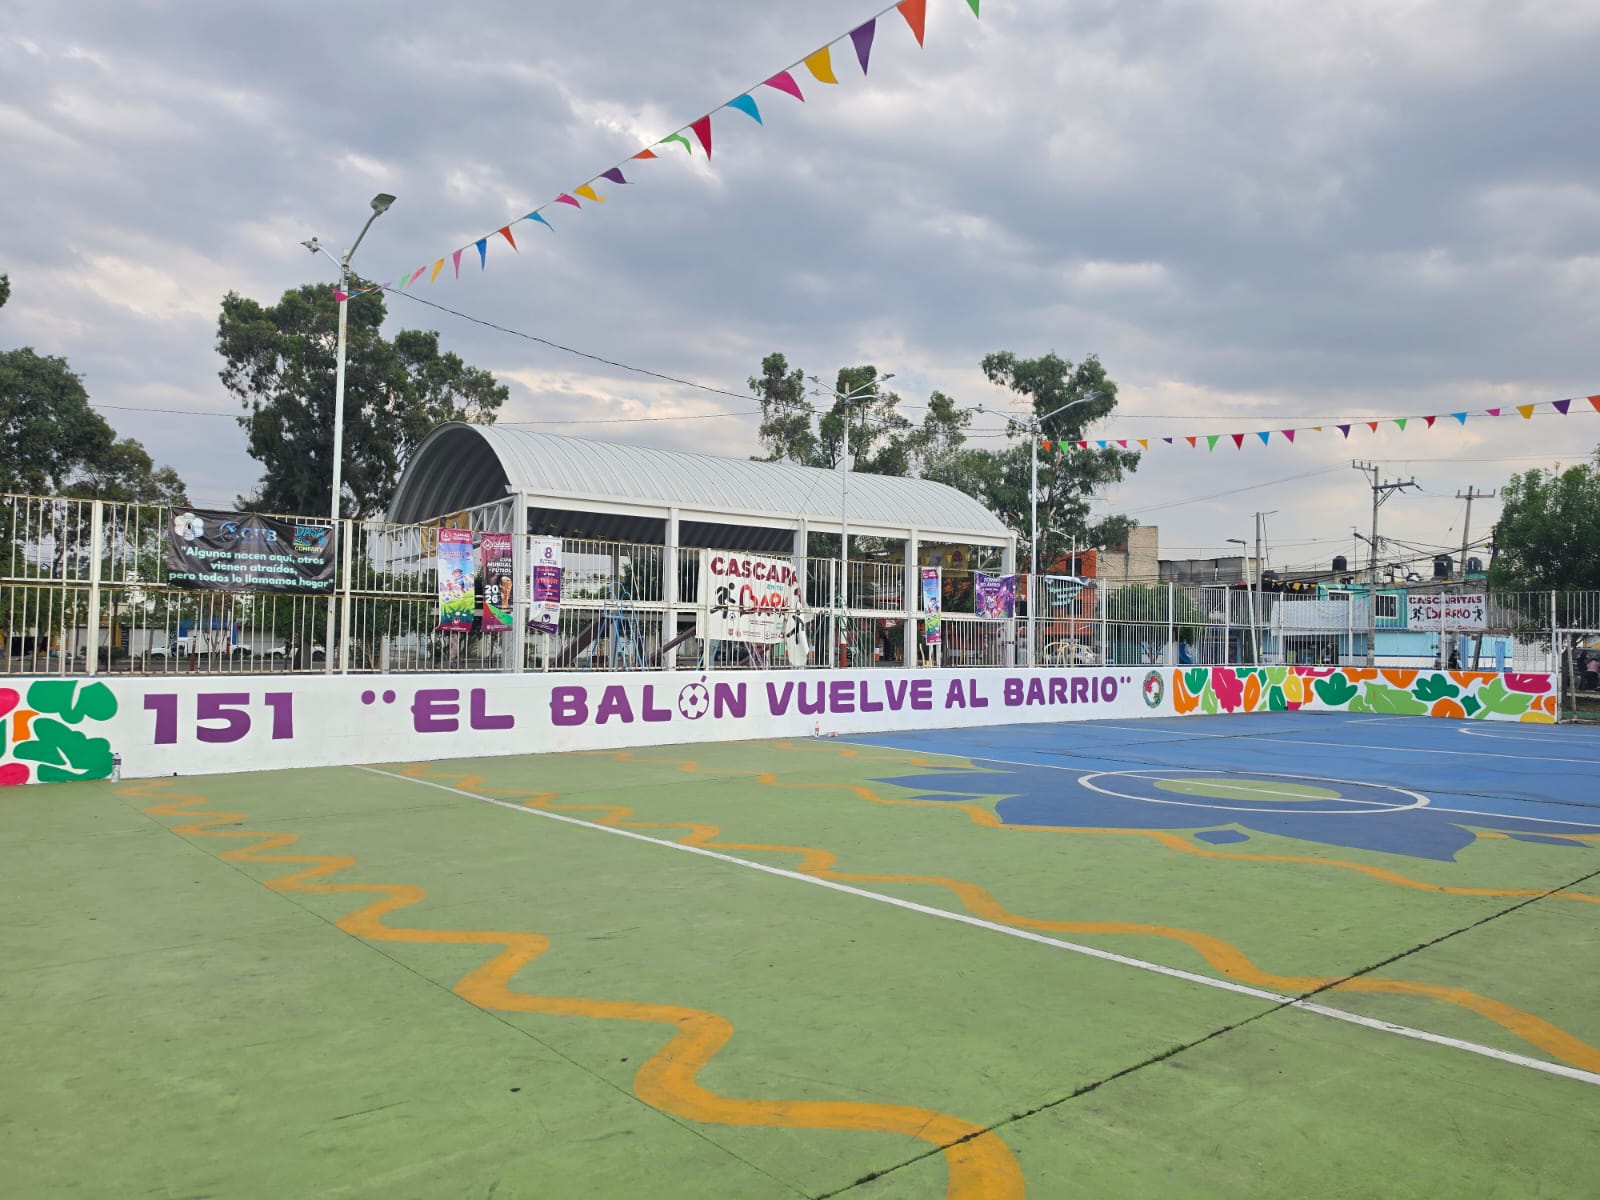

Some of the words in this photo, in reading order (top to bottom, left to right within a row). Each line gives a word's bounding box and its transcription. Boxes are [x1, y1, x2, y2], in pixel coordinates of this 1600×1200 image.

[181, 546, 232, 560] "Algunos
[269, 553, 295, 563] aquí,
[298, 556, 324, 564] otros
[545, 547, 552, 558] 8
[211, 563, 246, 571] vienen
[250, 563, 297, 574] atraídos,
[169, 573, 196, 581] pero
[198, 573, 229, 582] todos
[232, 574, 242, 582] lo
[245, 574, 296, 586] llamamos
[298, 578, 333, 588] hogar"
[485, 585, 499, 593] 20
[486, 595, 498, 603] 26
[143, 693, 293, 745] 151
[767, 680, 933, 716] VUELVE
[946, 679, 989, 709] AL
